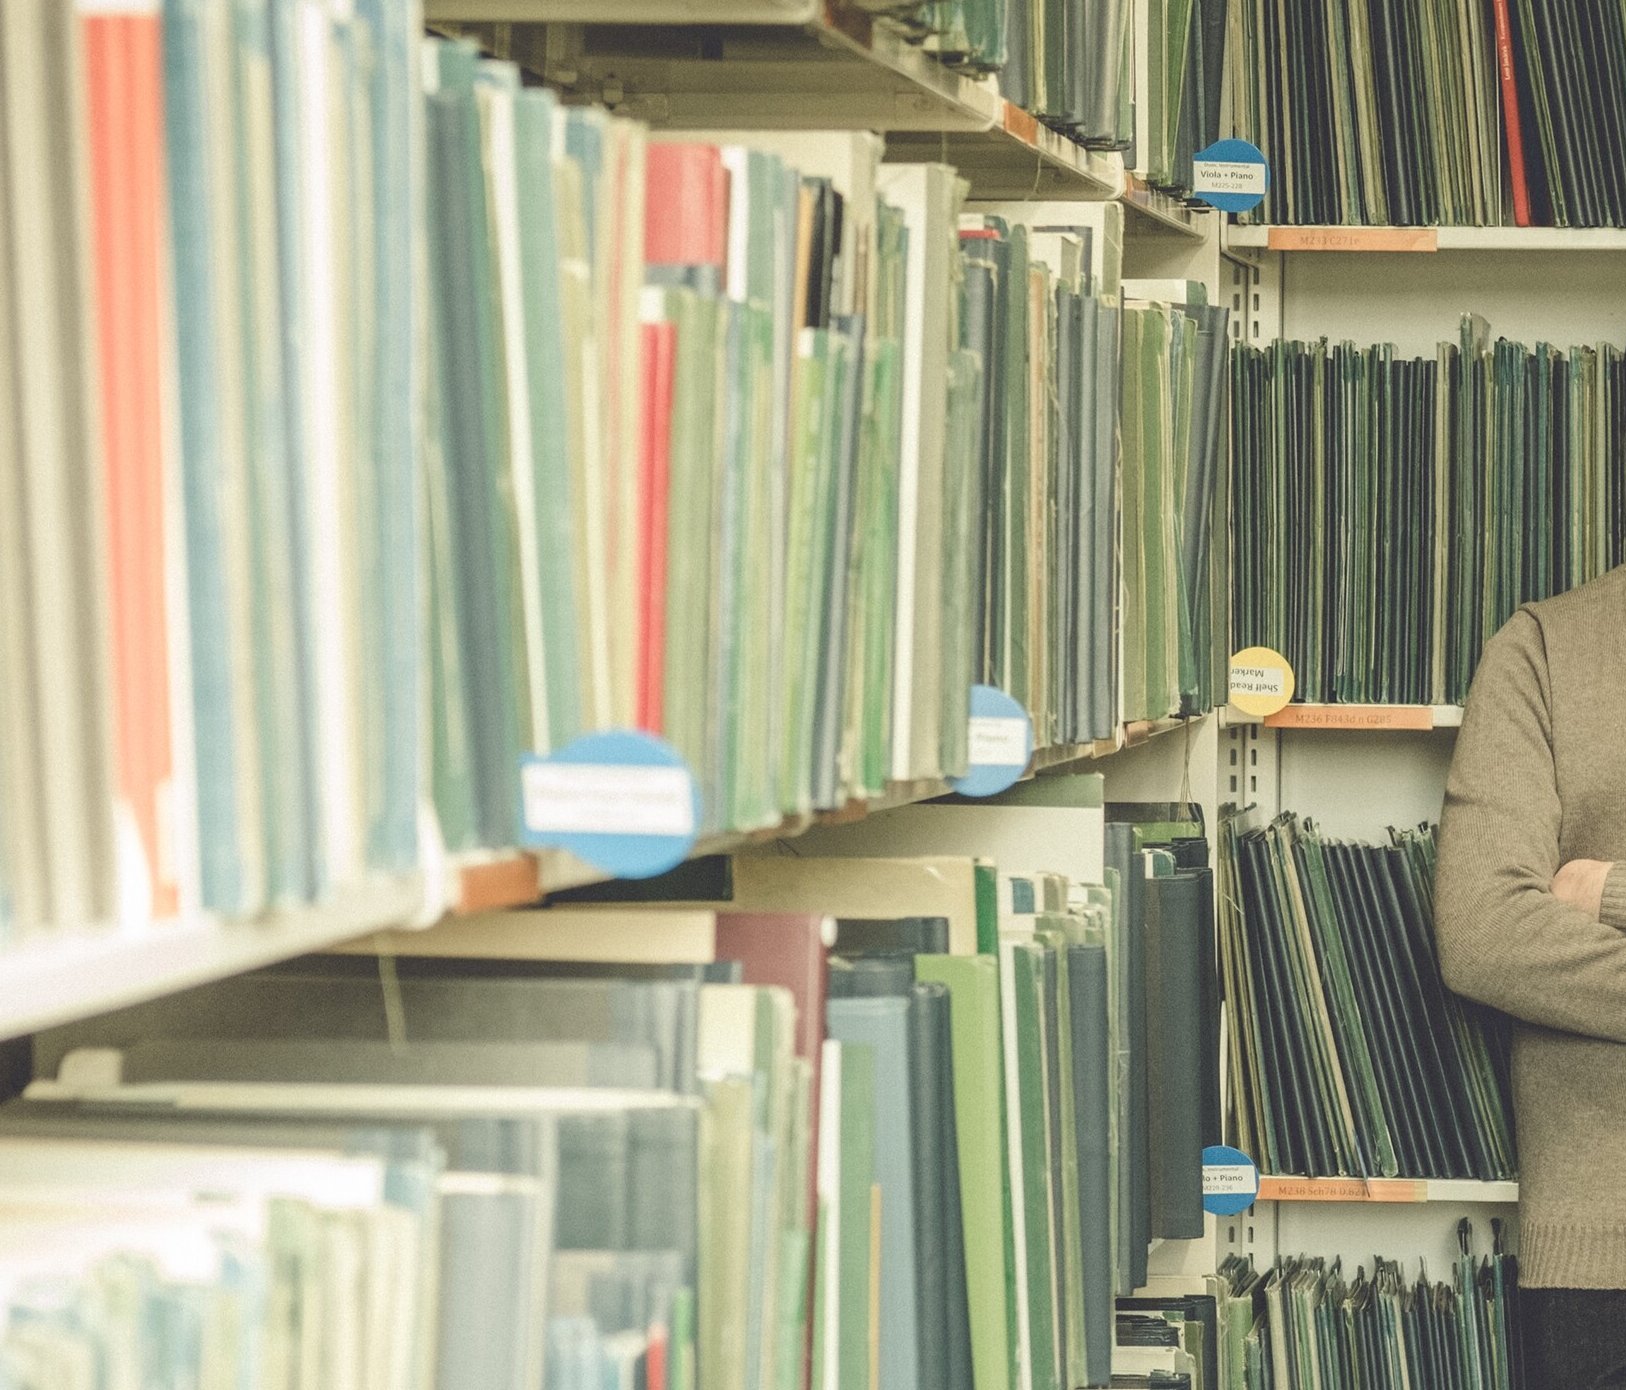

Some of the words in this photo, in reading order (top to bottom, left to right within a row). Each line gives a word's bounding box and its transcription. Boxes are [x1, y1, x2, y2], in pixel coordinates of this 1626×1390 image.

[1200, 169, 1222, 179] Viola
[1230, 170, 1254, 180] Piano
[1230, 668, 1265, 678] Marker
[1230, 682, 1254, 691] Read
[1255, 683, 1279, 693] Shelf
[1295, 714, 1322, 724] M236
[1220, 1174, 1244, 1182] Piano
